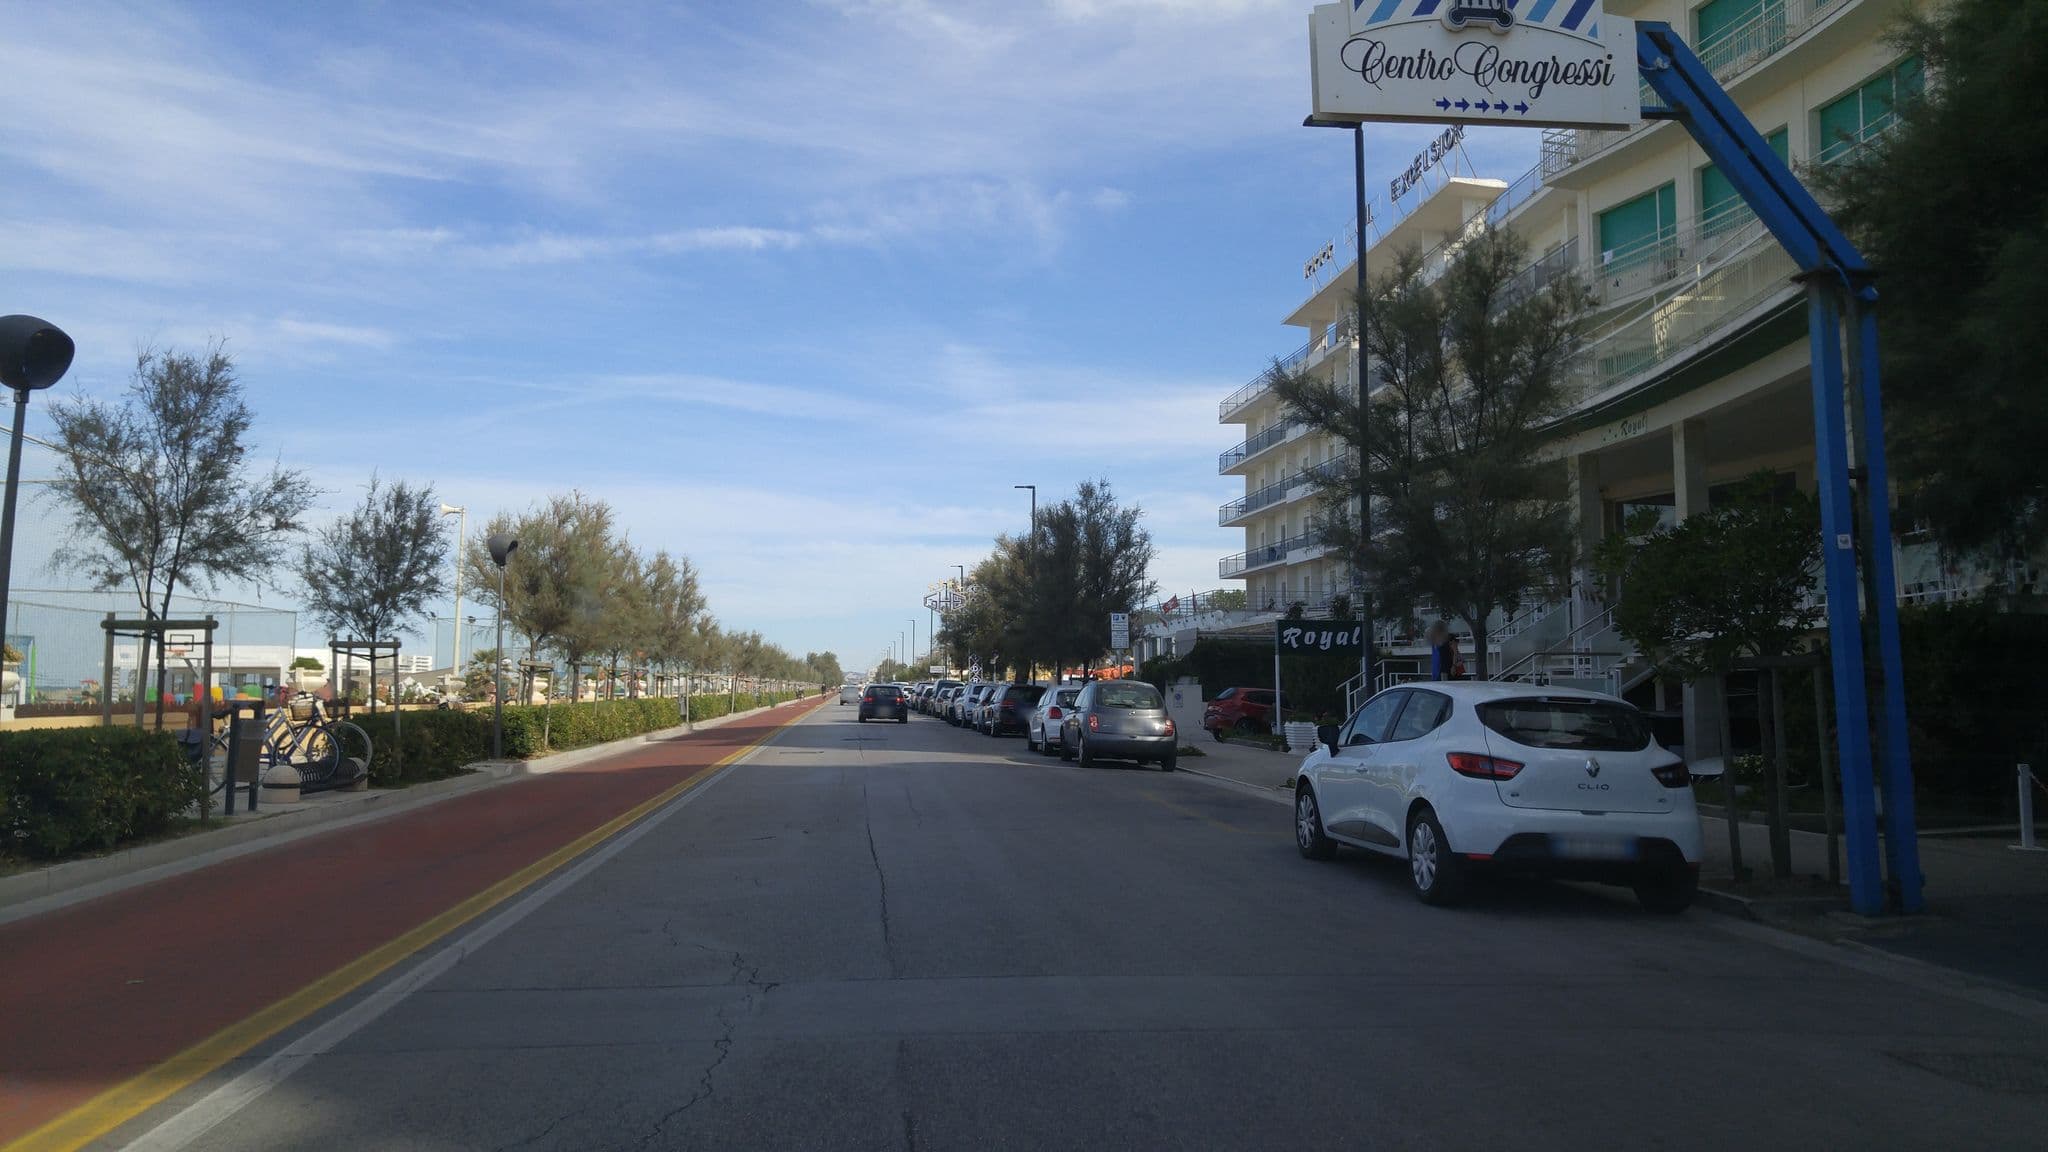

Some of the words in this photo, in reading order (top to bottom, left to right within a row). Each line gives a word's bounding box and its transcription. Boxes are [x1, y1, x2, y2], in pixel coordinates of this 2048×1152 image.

[1341, 38, 1454, 90] Centro
[1455, 41, 1615, 98] Congressi
[1282, 627, 1361, 650] Royal
[1577, 783, 1610, 791] CLIO
